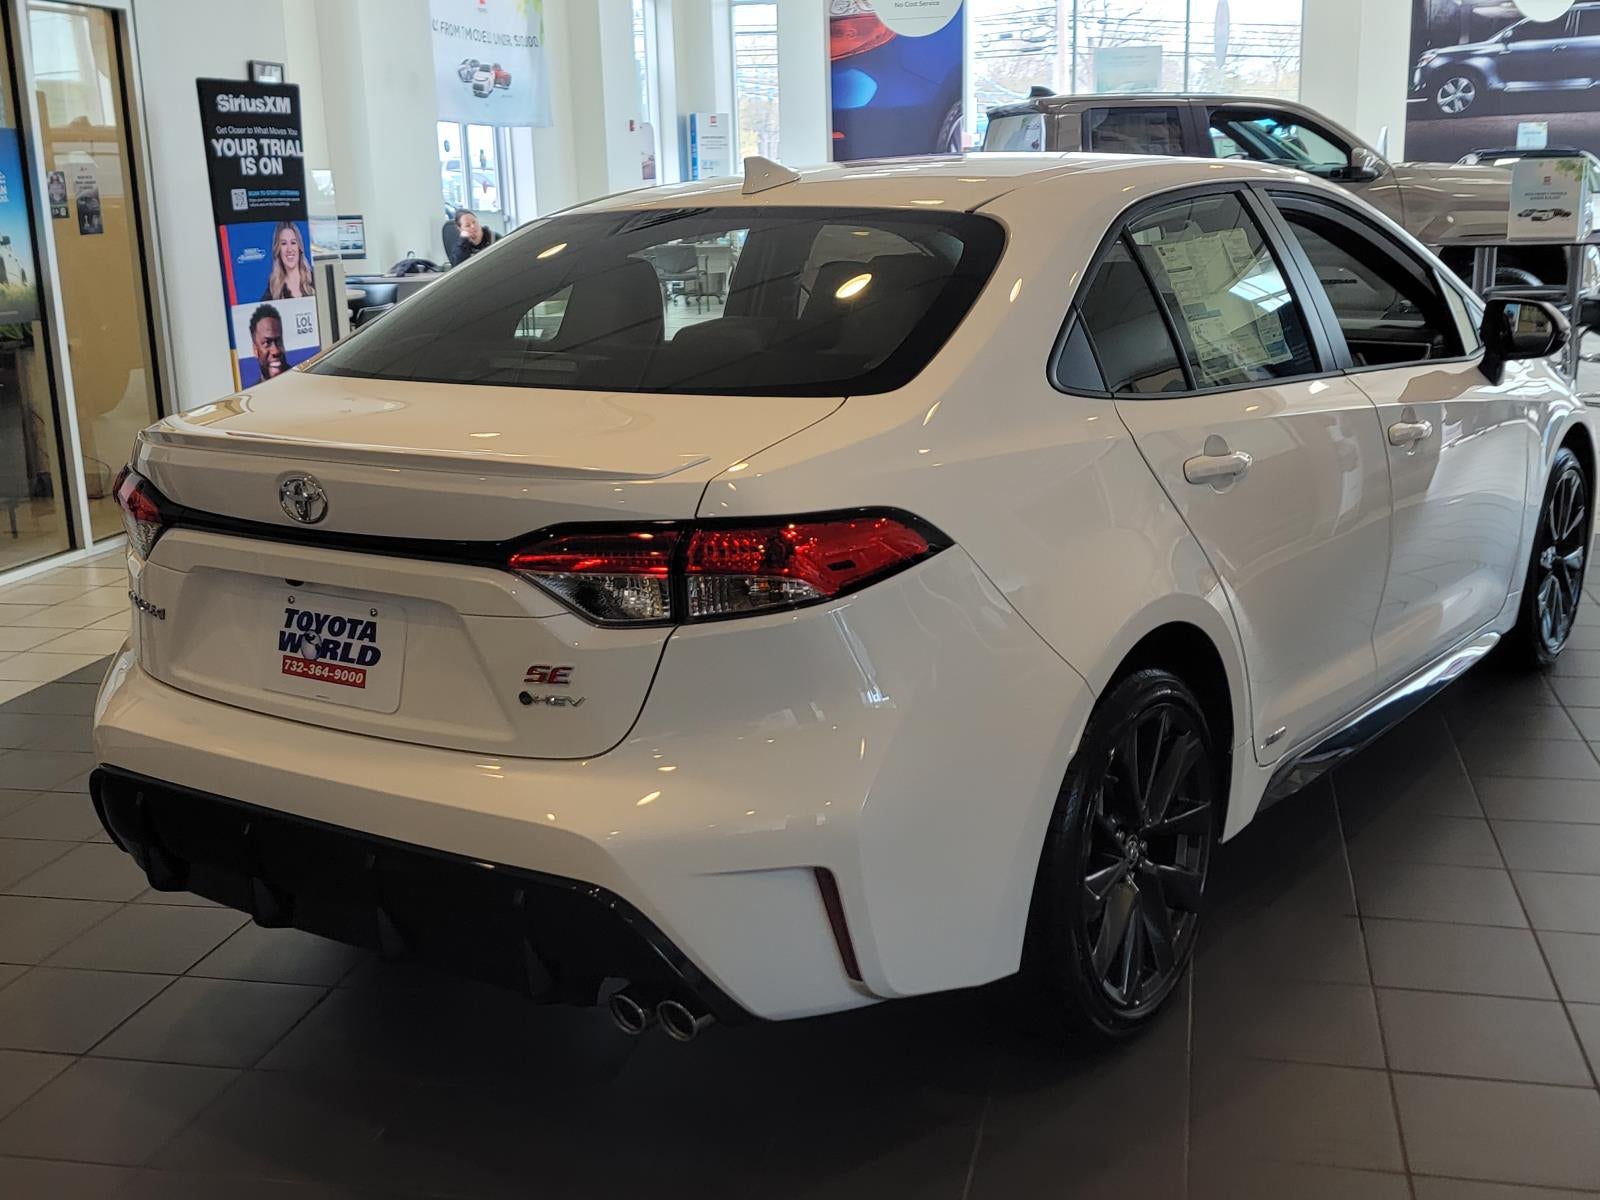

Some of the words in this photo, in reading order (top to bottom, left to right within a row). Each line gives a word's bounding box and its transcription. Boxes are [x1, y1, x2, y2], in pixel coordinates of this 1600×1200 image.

[216, 94, 291, 114] SiriusXM
[211, 138, 258, 157] YOUR
[259, 138, 304, 157] TRIAL
[241, 157, 257, 175] IS
[259, 157, 283, 175] ON
[296, 315, 312, 328] LOL
[284, 608, 377, 643] TOYOTA
[278, 630, 382, 667] WRLD
[284, 659, 364, 684] 732-364-9000
[524, 665, 574, 685] SE
